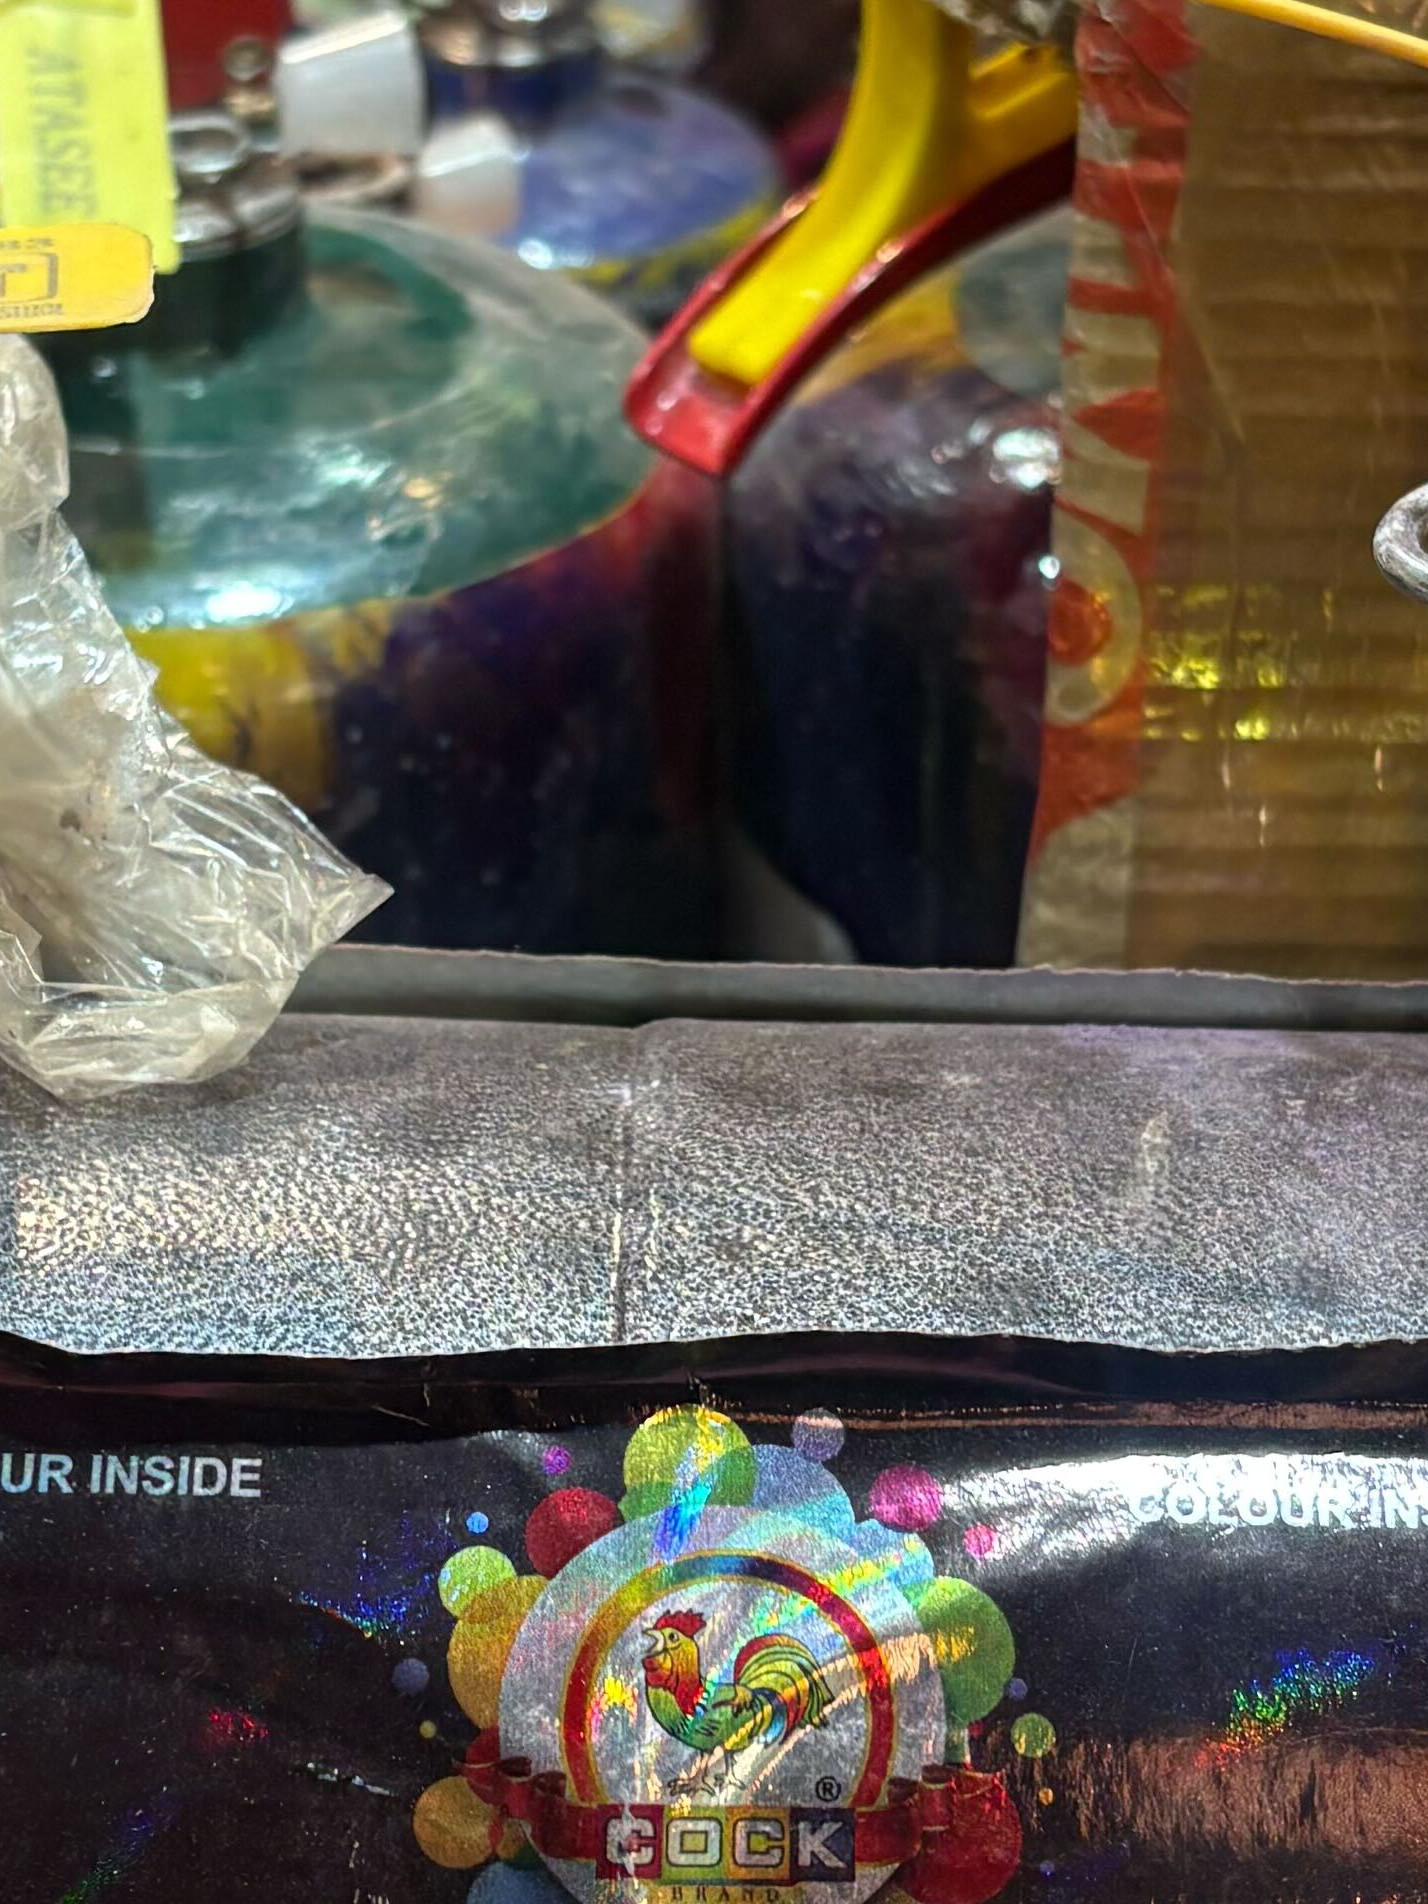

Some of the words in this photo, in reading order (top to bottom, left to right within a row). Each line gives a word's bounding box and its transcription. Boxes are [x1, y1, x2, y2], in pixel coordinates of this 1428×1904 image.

[91, 1454, 262, 1497] INSIDE
[1129, 1486, 1355, 1529] COLOUR
[605, 1816, 847, 1870] COCK
